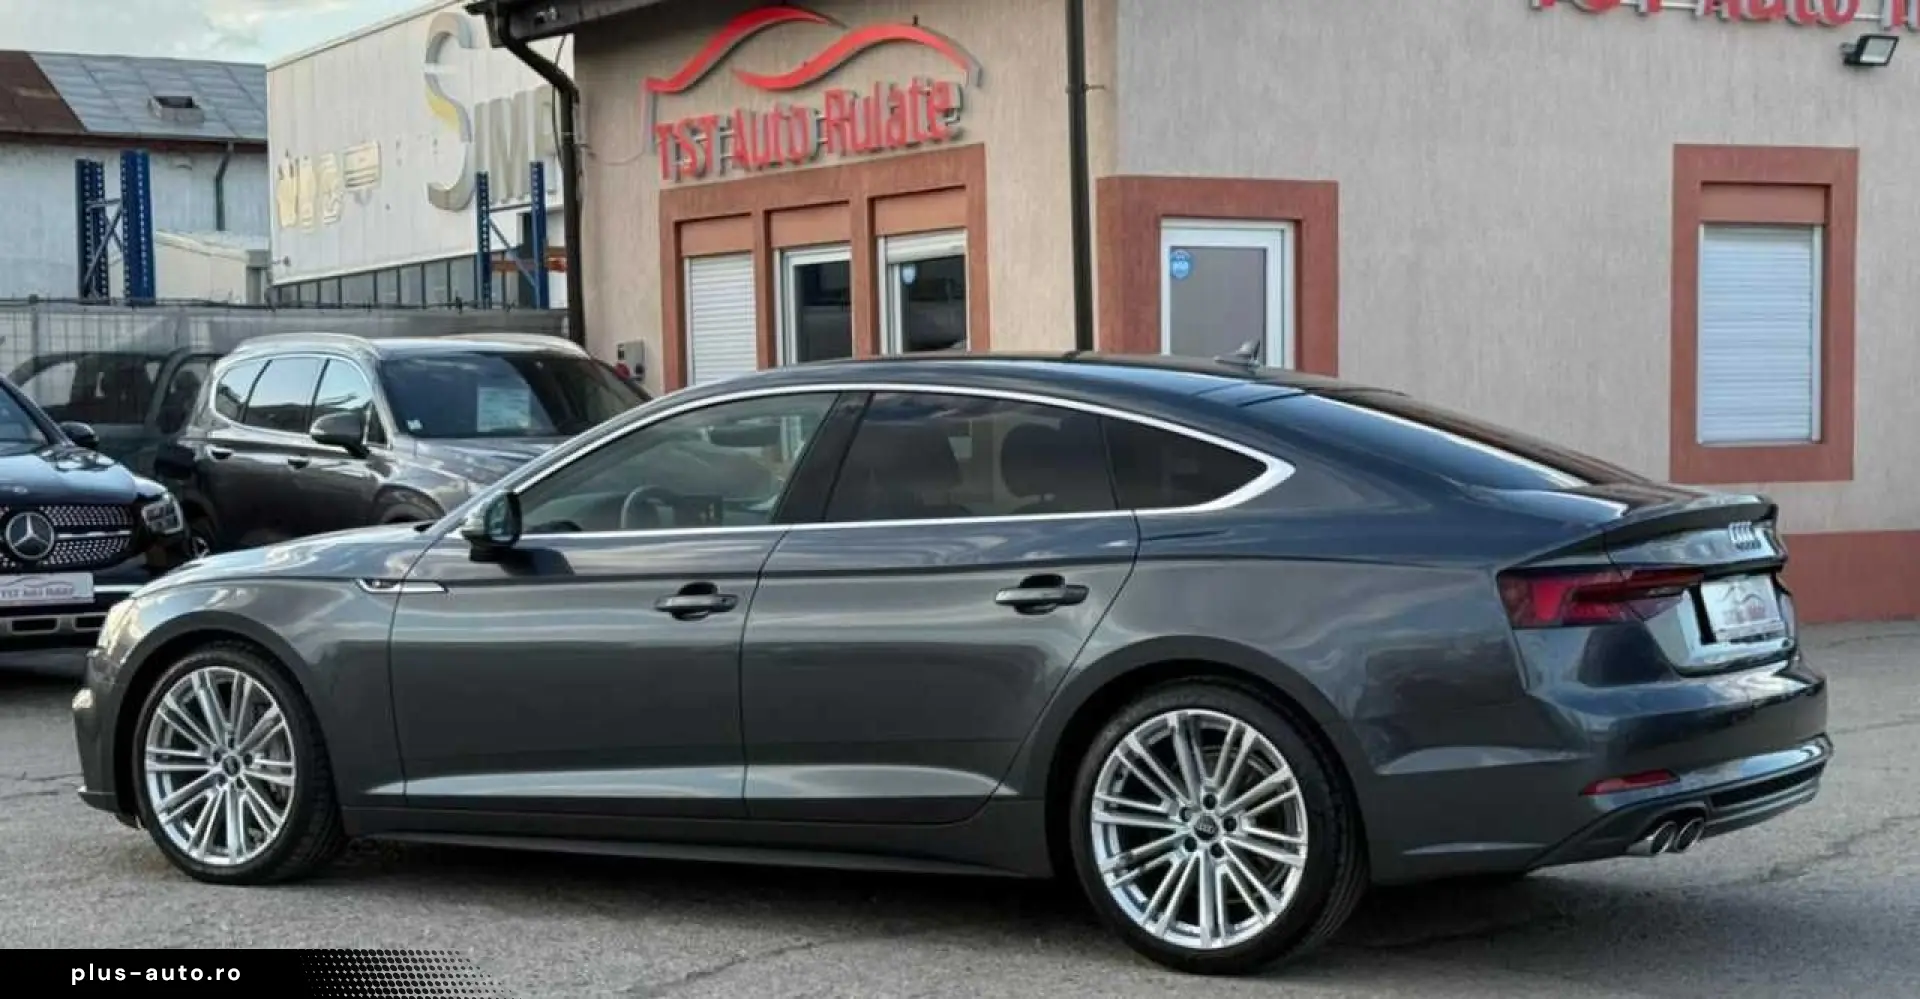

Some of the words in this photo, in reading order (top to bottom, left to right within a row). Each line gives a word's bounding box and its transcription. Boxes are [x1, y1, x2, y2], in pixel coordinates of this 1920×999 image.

[655, 113, 726, 180] TST
[731, 102, 815, 171] Auto
[824, 76, 959, 155] Rulate
